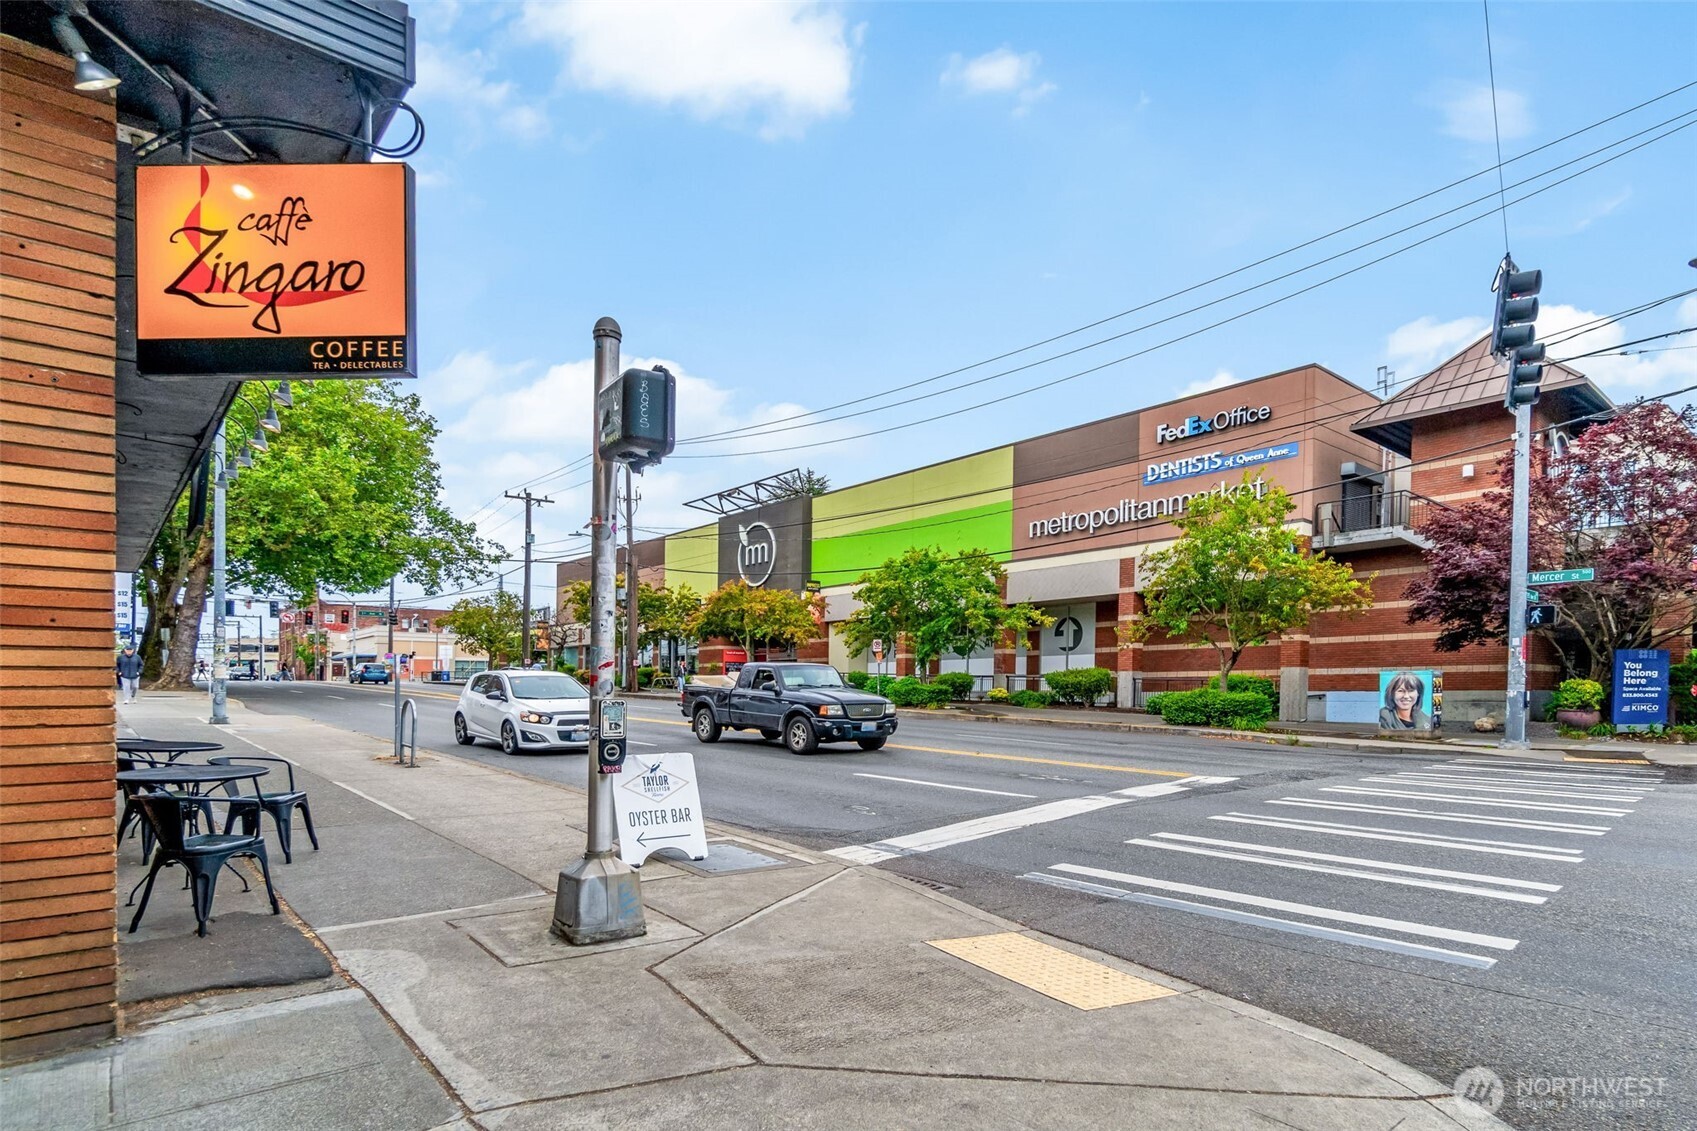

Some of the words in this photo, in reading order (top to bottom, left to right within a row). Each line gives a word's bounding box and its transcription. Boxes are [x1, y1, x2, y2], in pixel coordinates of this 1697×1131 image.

[237, 196, 313, 246] caffè
[164, 226, 365, 334] Zingaro
[310, 340, 404, 358] COFFEE
[313, 361, 331, 370] TEA
[340, 361, 404, 369] DELECTABLES
[1213, 405, 1272, 431] Office
[1147, 451, 1222, 482] DENTISTS
[1224, 456, 1235, 467] of
[1236, 453, 1264, 465] Queen
[1267, 448, 1290, 458] Anne
[1532, 573, 1565, 582] Mercer
[1571, 572, 1580, 580] St
[1623, 661, 1642, 669] You
[1623, 670, 1658, 678] Belong
[1623, 677, 1647, 685] Here
[642, 775, 670, 787] TAYLOR
[628, 809, 668, 827] OYSTER
[670, 807, 692, 823] BAR
